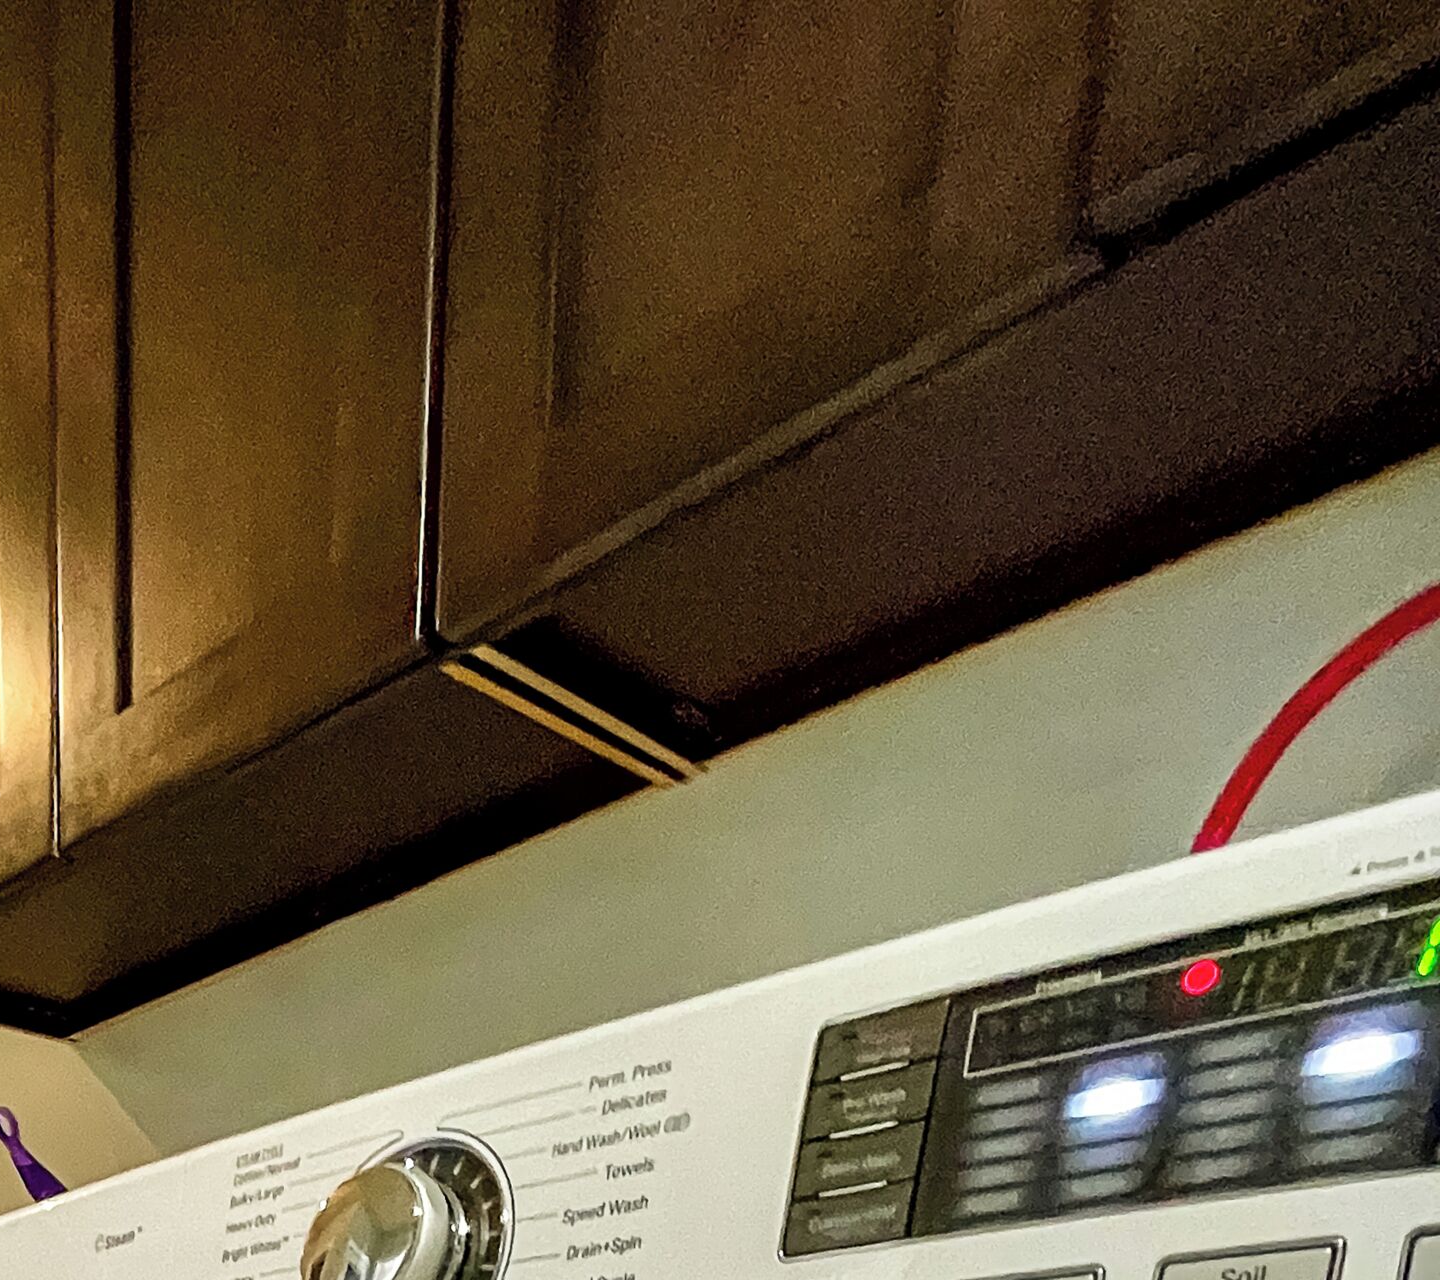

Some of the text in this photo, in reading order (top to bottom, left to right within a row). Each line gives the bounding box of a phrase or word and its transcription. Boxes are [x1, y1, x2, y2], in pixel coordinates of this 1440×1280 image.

[606, 1157, 655, 1180] Towels
[562, 1195, 649, 1226] Speed Wash
